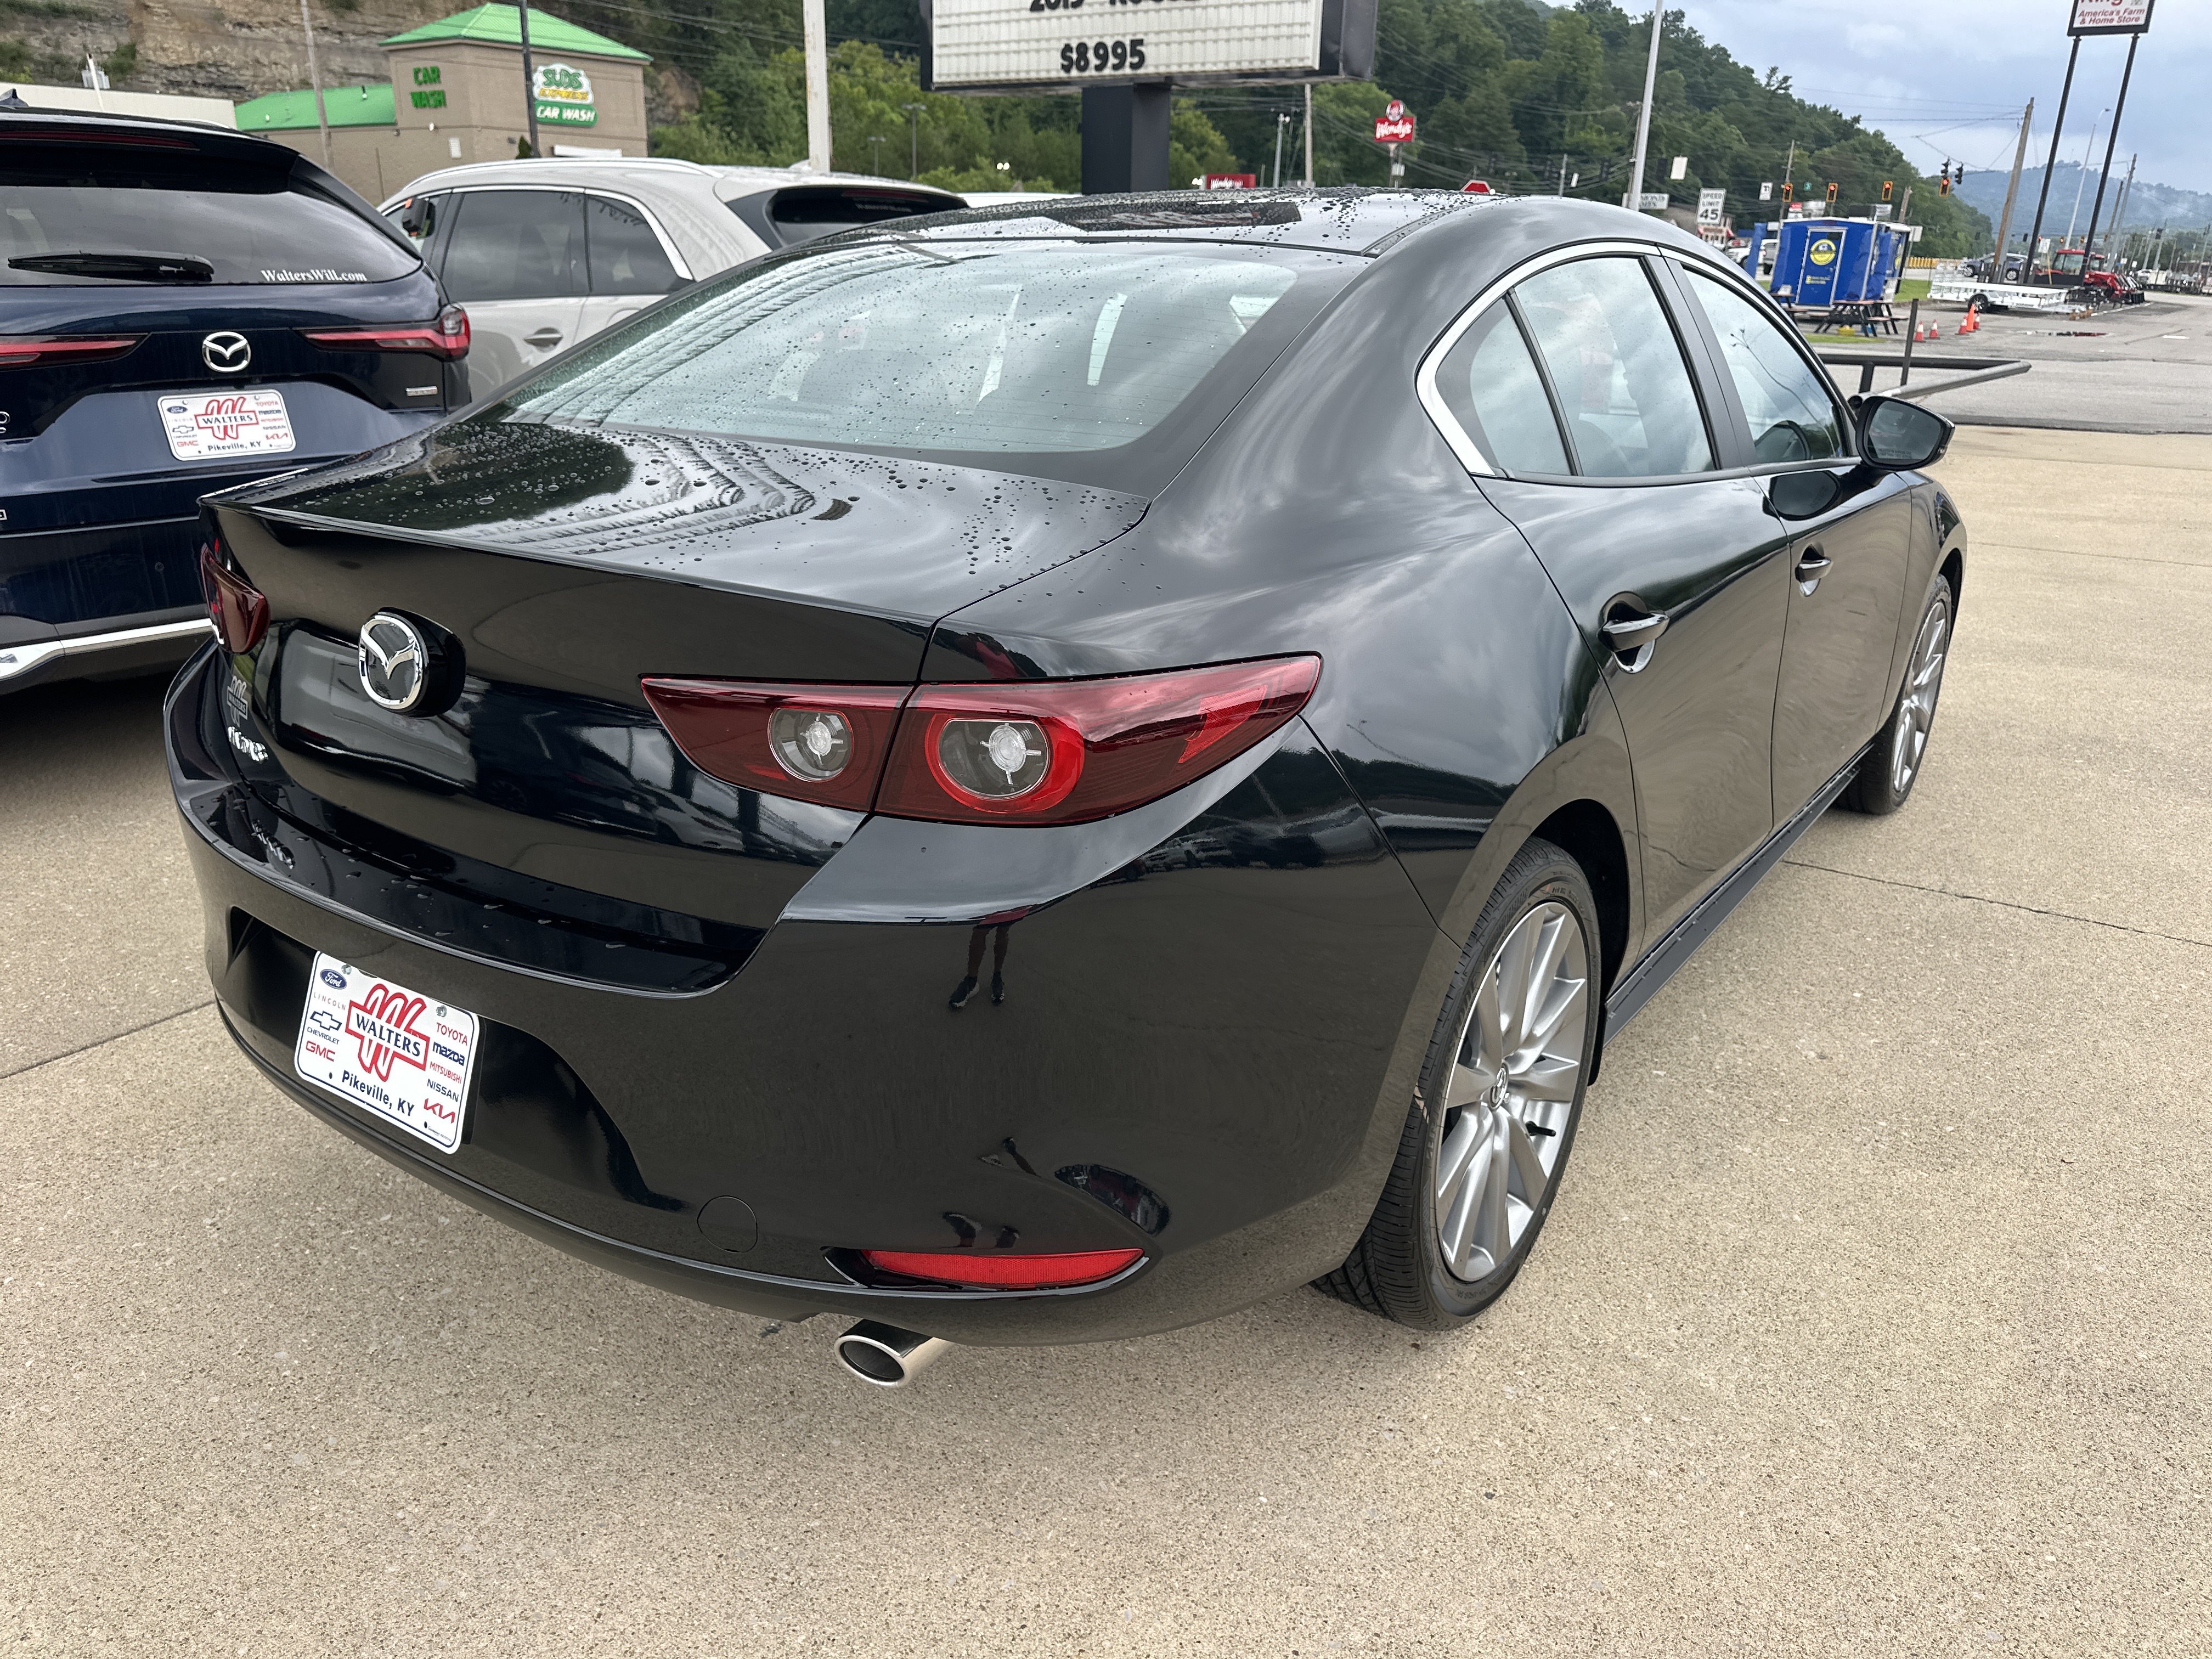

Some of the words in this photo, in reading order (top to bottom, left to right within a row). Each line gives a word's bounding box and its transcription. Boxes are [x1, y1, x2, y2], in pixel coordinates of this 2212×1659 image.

[2078, 9, 2120, 17] America's
[1061, 38, 1144, 72] $8995
[413, 66, 441, 84] CAR
[543, 69, 582, 89] SUDS
[410, 91, 447, 108] WASH
[537, 105, 560, 119] CAR
[562, 108, 595, 122] WASH
[1700, 209, 1719, 220] 45
[261, 269, 367, 281] WaltersWill.com
[202, 415, 253, 424] WALTERS
[208, 443, 247, 451] Pikeville,
[325, 972, 342, 987] Ford
[313, 991, 346, 1011] LINCOLN
[307, 1026, 340, 1045] CHEVROLET
[356, 1013, 421, 1057] WALTERS
[437, 1022, 467, 1046] TOYOTA
[306, 1041, 336, 1062] GMC
[433, 1041, 465, 1066] mazda
[430, 1061, 462, 1084] MITSUBISHI
[342, 1070, 392, 1109] Pikeville,
[397, 1098, 415, 1116] KY
[427, 1079, 459, 1102] NISSAN
